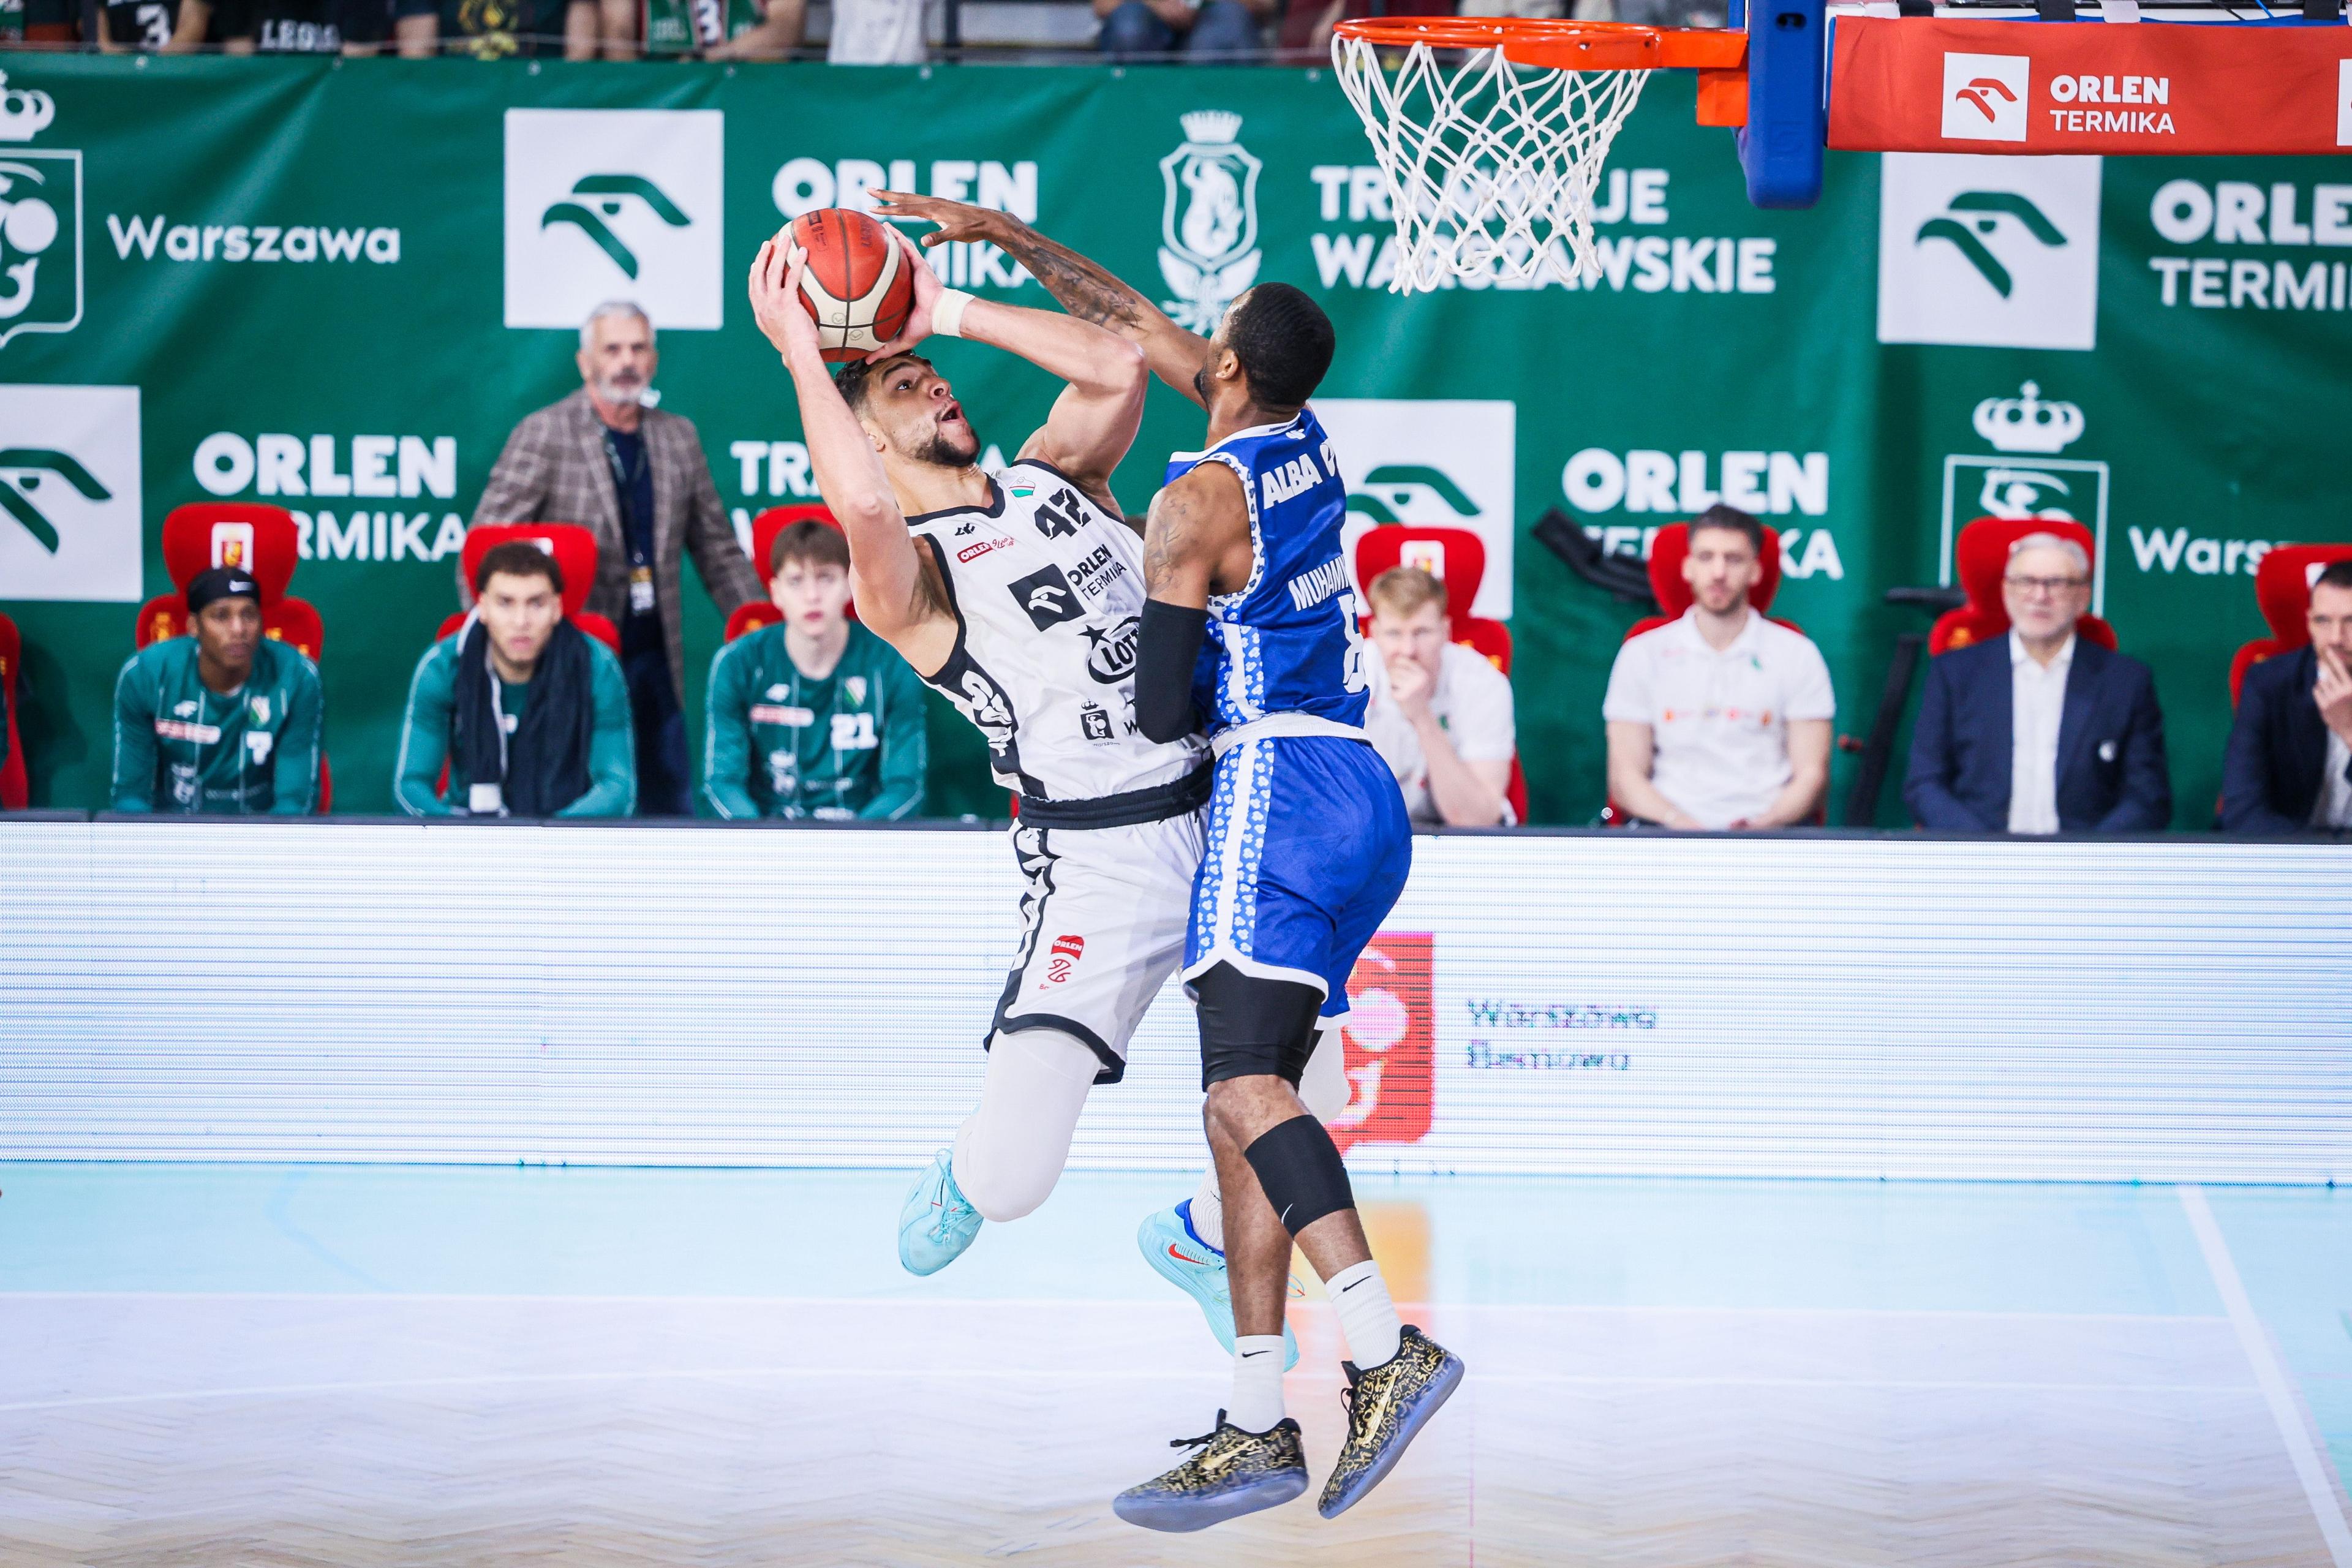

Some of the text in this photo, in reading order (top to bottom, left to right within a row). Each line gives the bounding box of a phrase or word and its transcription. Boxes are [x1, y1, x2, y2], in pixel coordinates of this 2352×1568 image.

[2050, 75, 2169, 105] ORLEN
[2049, 110, 2176, 134] TERMIKA
[771, 157, 1039, 224] ORLEN
[2150, 178, 2352, 246] ORLE
[107, 213, 401, 264] Warszawa
[2149, 256, 2352, 311] TERMI
[192, 431, 457, 499] ORLEN
[1261, 453, 1323, 509] ALBA
[1562, 448, 1829, 516] ORLEN
[291, 510, 467, 562] RMIKA
[1034, 488, 1092, 540] 42
[1067, 543, 1113, 586] ORLEN
[2127, 525, 2272, 576] Wars
[1101, 627, 1139, 673] LOT
[830, 712, 878, 750] 21
[1054, 940, 1083, 951] ORLEN
